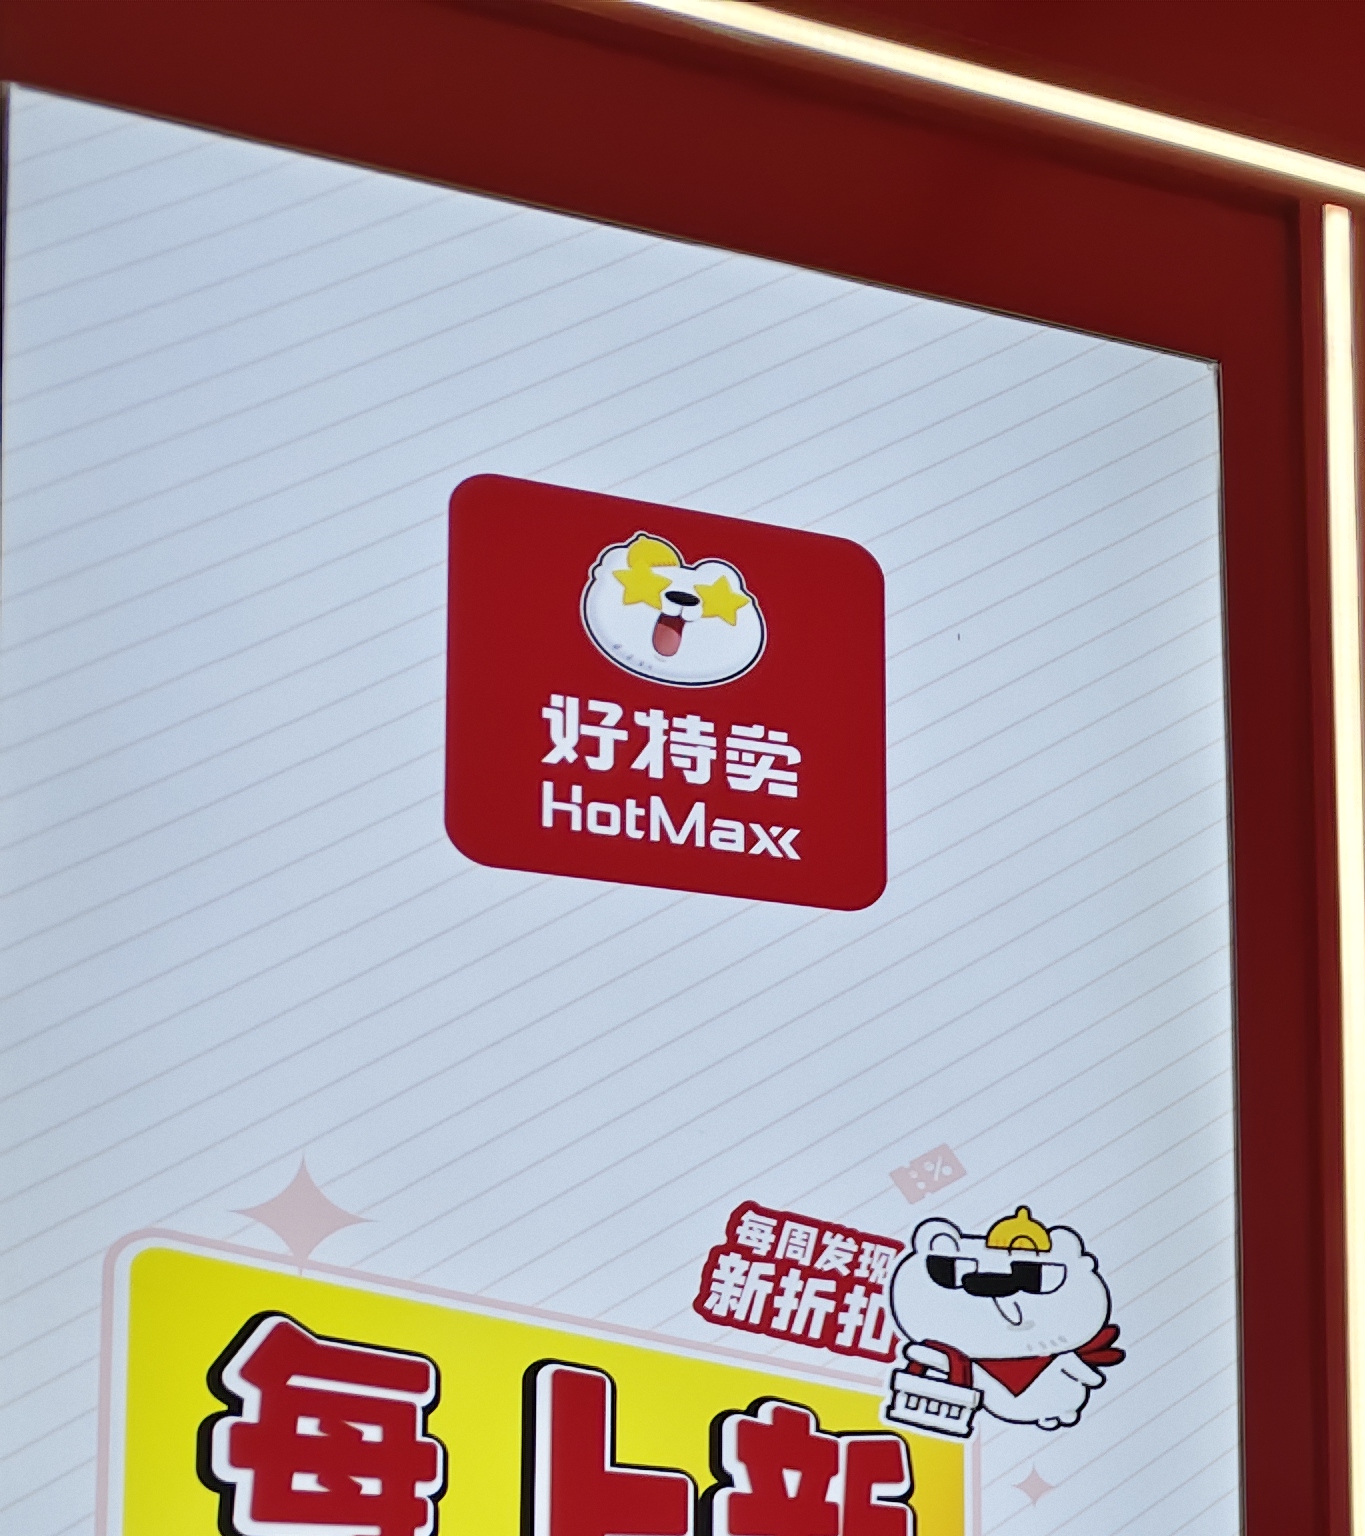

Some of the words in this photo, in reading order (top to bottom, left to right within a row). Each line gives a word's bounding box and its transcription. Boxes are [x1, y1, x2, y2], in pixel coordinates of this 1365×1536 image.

[541, 694, 803, 798] 好特卖
[736, 1211, 898, 1284] 每周发现
[704, 1253, 896, 1354] 新折扣
